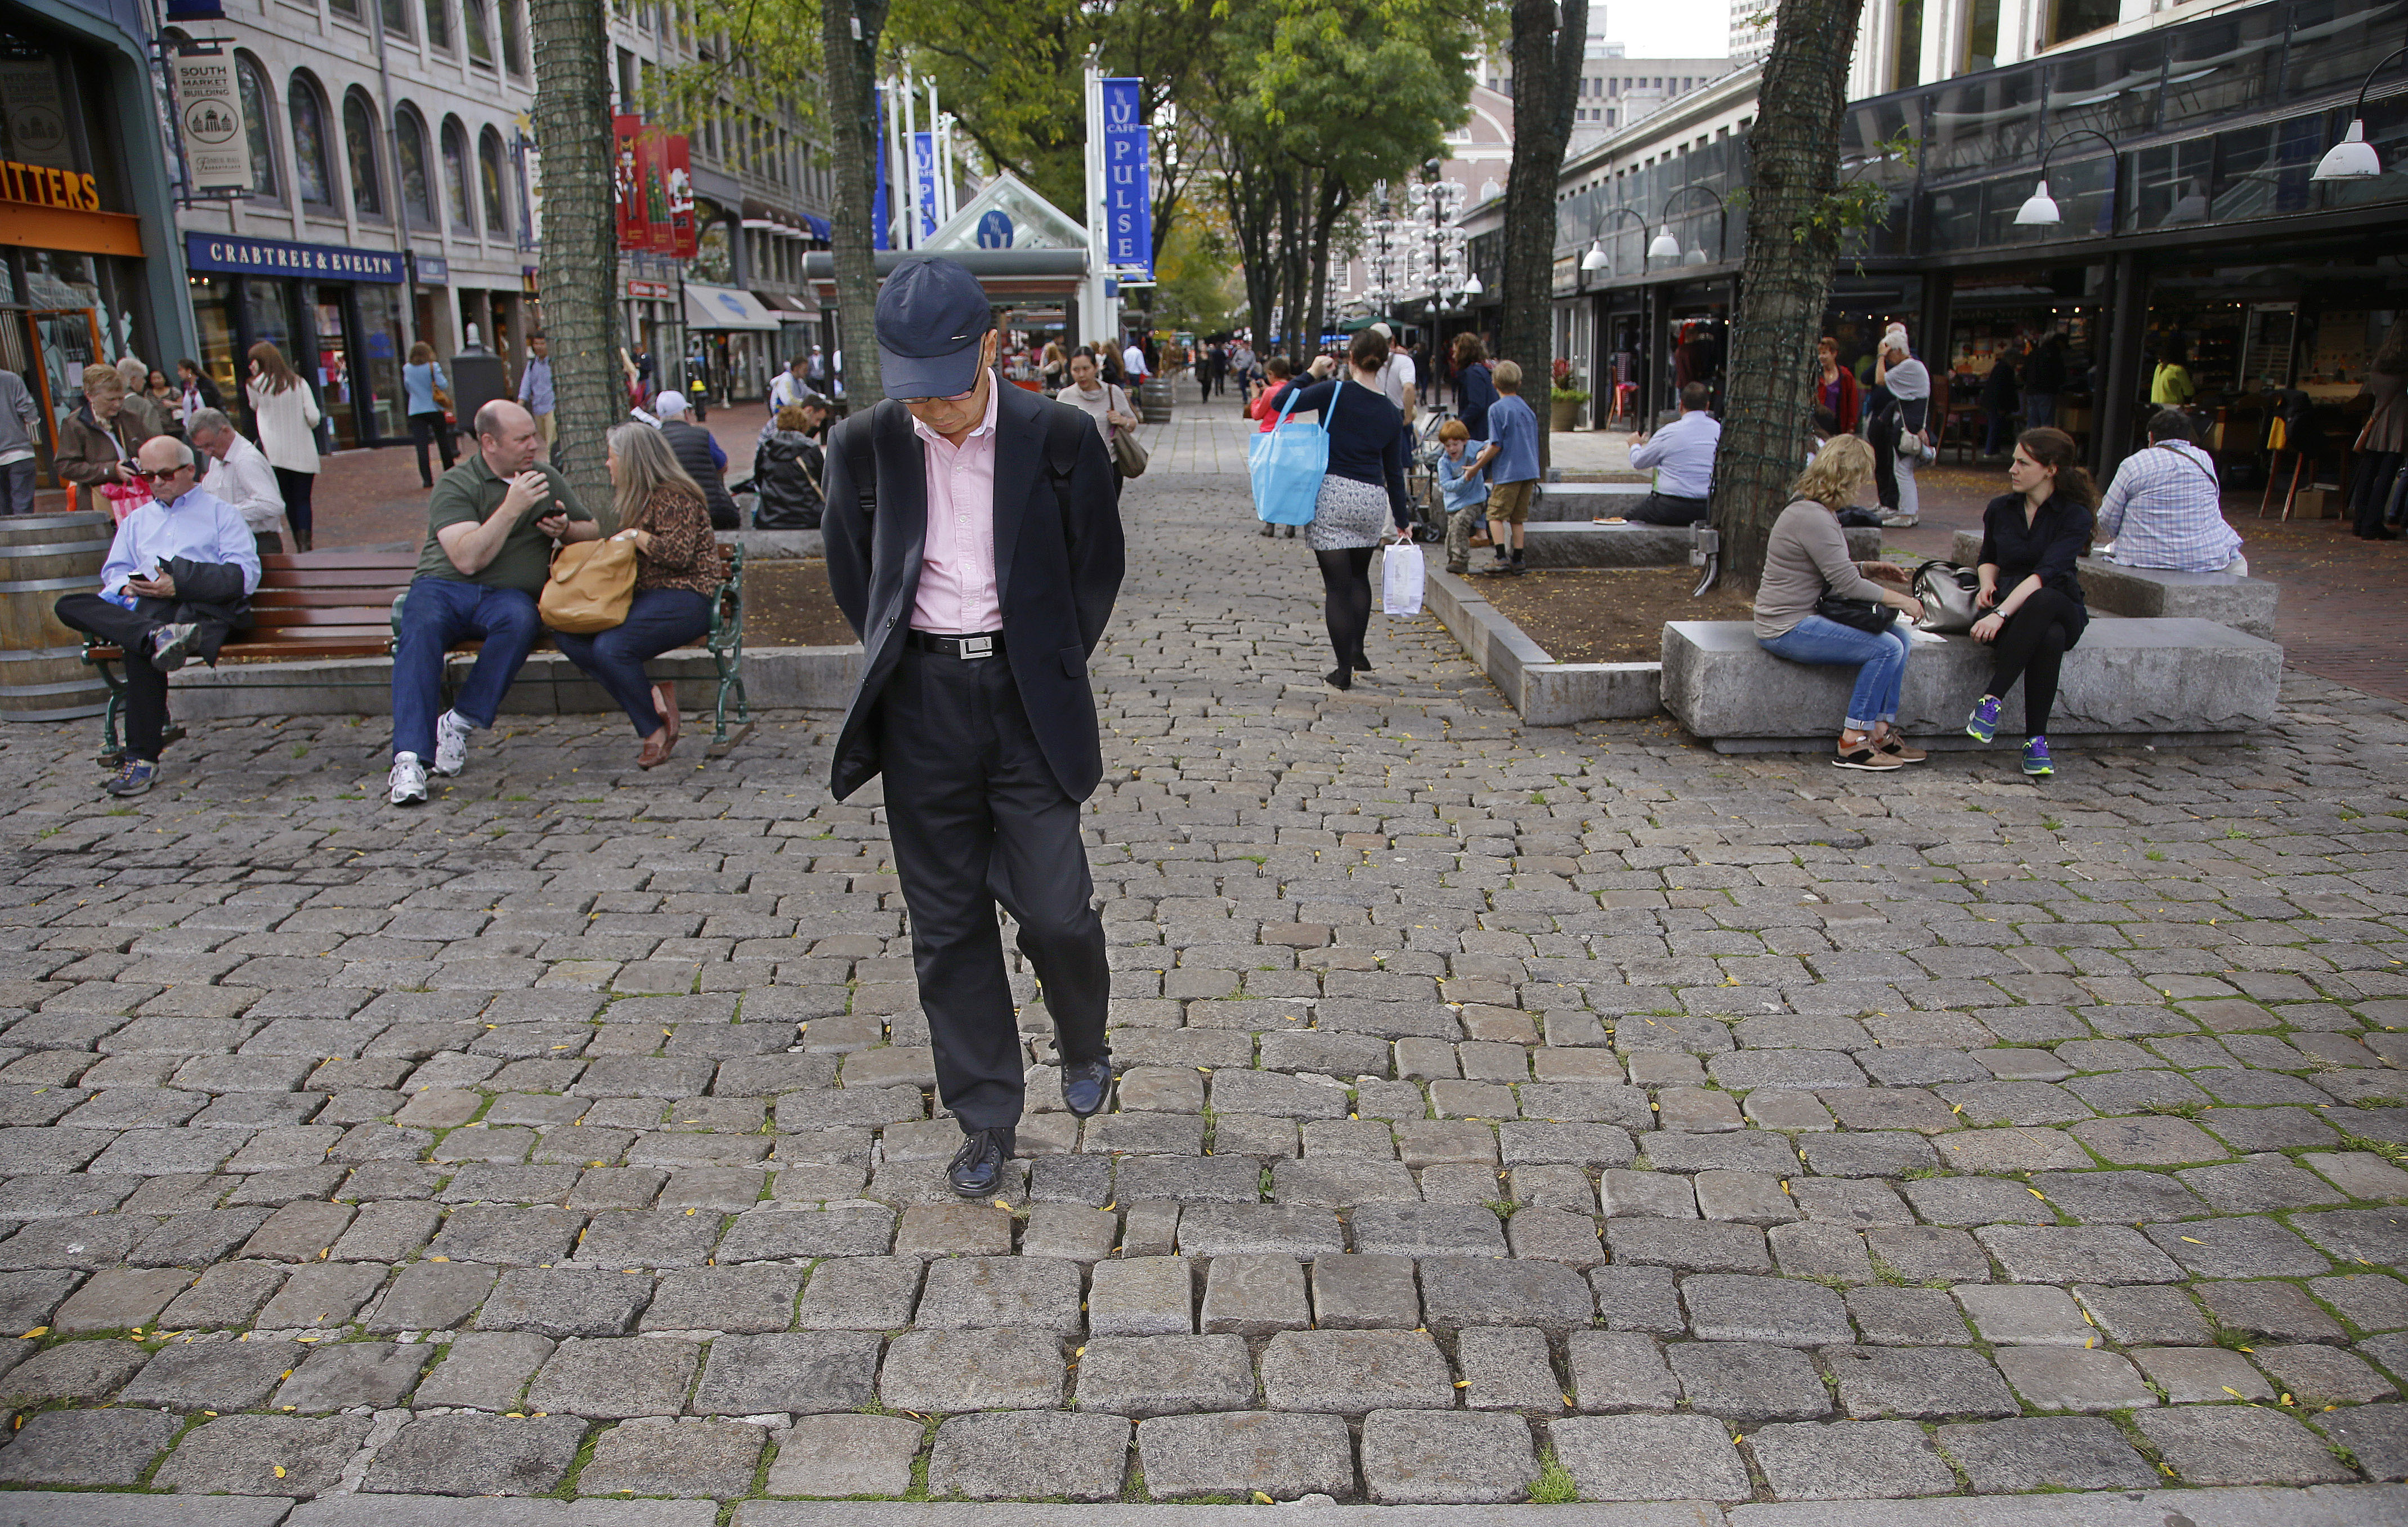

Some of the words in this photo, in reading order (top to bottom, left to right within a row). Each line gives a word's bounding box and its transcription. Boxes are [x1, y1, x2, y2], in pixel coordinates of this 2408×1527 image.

[181, 66, 226, 76] SOUTH
[919, 169, 934, 178] AFE
[1113, 140, 1133, 258] PULSE
[211, 242, 311, 269] CRABTREE
[317, 252, 328, 269] &
[332, 253, 392, 274] EVELYN
